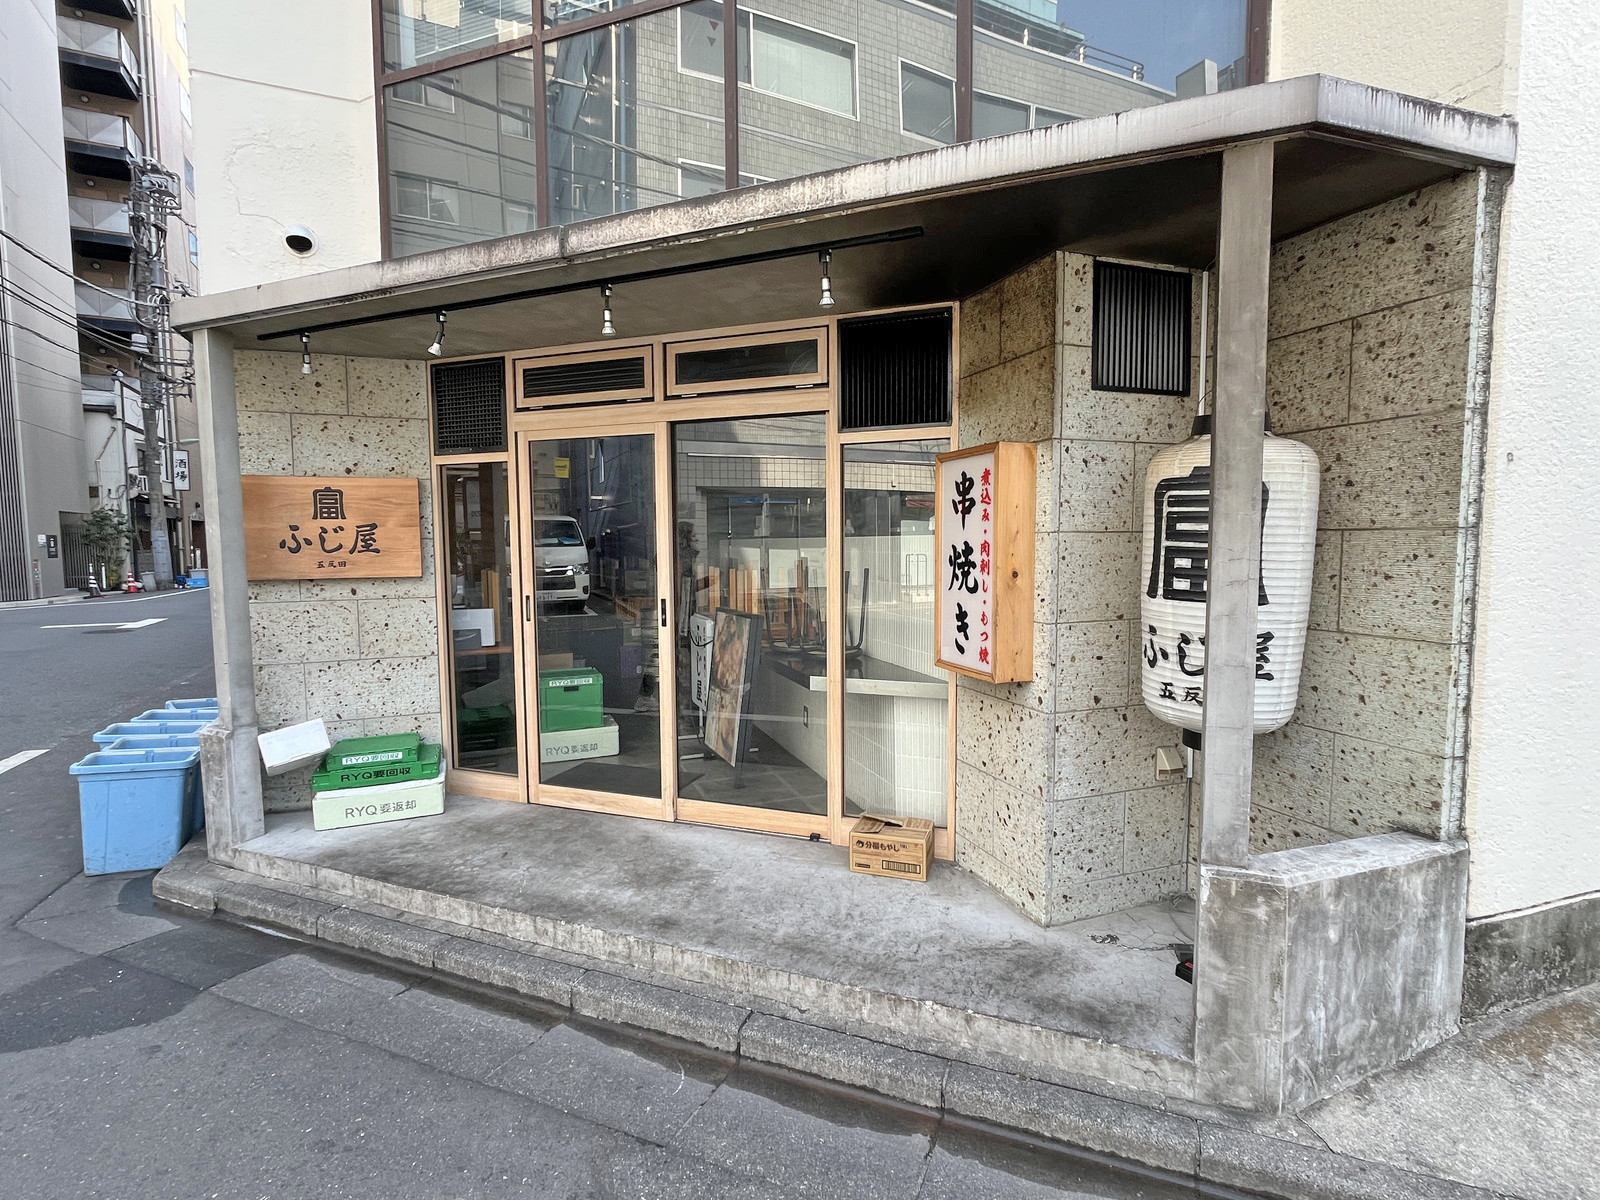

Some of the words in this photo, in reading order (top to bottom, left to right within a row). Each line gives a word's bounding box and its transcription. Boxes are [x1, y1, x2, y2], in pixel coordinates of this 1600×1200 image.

[175, 458, 188, 482] 酒場
[279, 522, 381, 554] ふじ屋
[316, 560, 347, 569] 五反田
[948, 471, 979, 655] 串焼き
[978, 467, 992, 665] 煮込み・肉刺し・もつ焼
[1159, 682, 1204, 707] 五反
[340, 767, 411, 782] RYQ要回収
